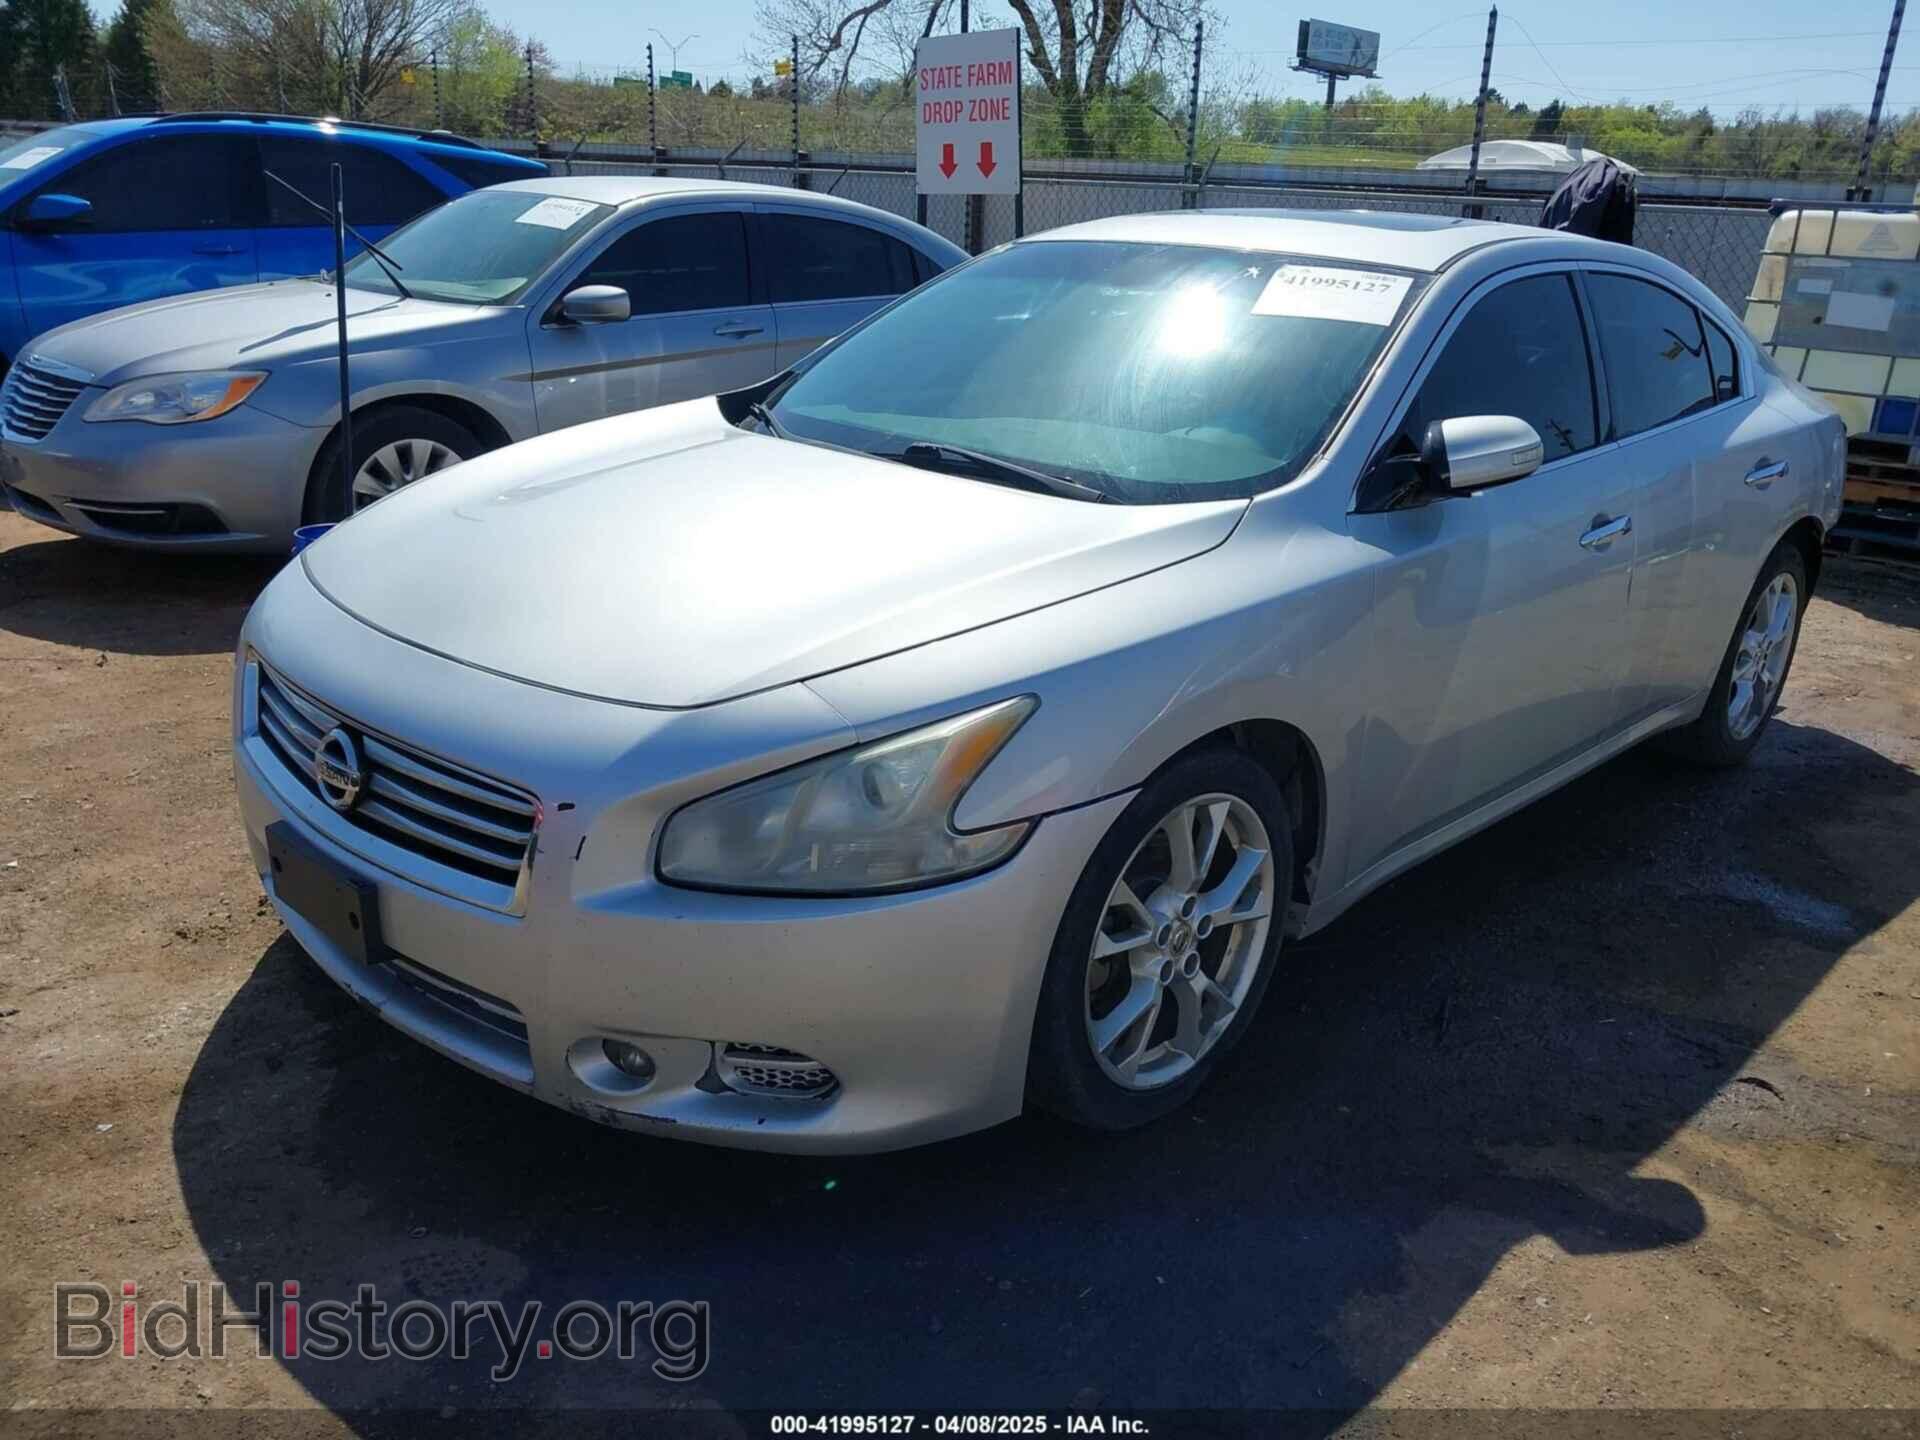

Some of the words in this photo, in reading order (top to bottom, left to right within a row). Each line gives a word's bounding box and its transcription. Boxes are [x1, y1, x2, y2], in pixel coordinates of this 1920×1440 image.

[920, 65, 962, 91] STATE
[967, 61, 1013, 88] FARM
[923, 99, 964, 124] DROP
[968, 97, 1010, 123] ZONE
[1283, 275, 1393, 294] 41995127
